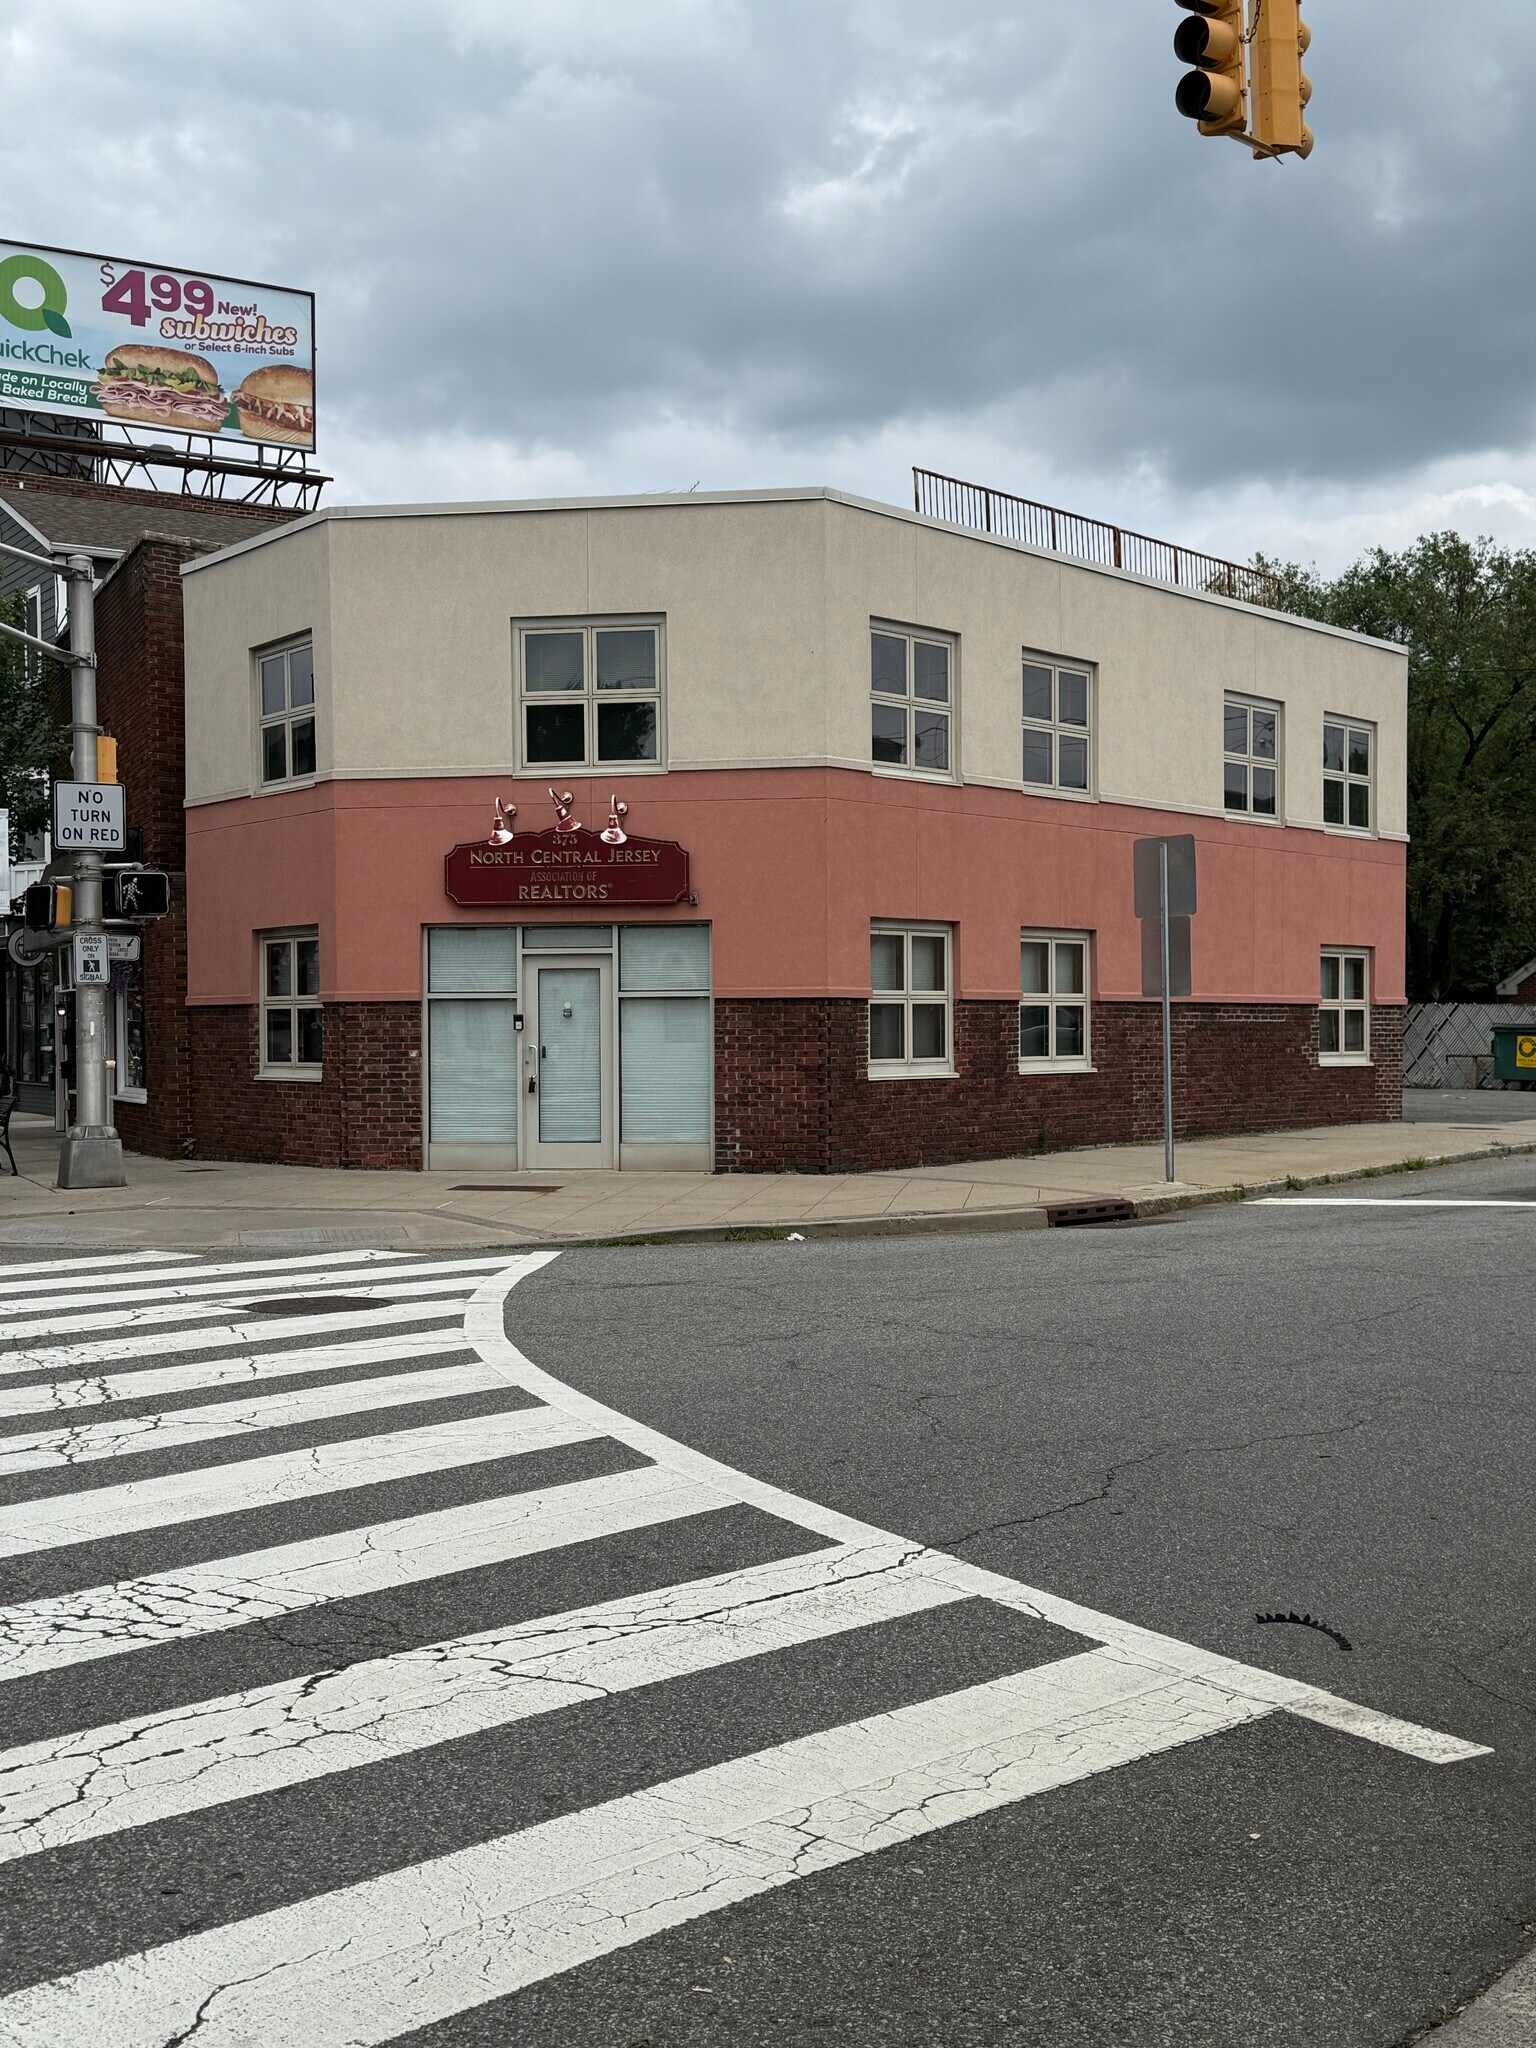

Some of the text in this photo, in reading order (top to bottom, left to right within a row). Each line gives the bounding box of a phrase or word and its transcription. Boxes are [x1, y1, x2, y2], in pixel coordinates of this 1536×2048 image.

[217, 301, 258, 316] New!
[160, 313, 297, 346] subwiches
[184, 342, 295, 356] or Select 6-inch Subs
[0, 371, 87, 395] de on Locally
[2, 383, 88, 404] Baked Bread
[78, 790, 103, 804] NO
[70, 809, 111, 823] TURN
[62, 827, 120, 841] ON RED
[470, 848, 662, 865] NORTH CENTRAL JERSEY
[530, 871, 597, 882] ASSOCIATION OF
[79, 936, 103, 945] CROSS
[82, 945, 99, 953] ONLY
[79, 973, 105, 981] SIGNAL
